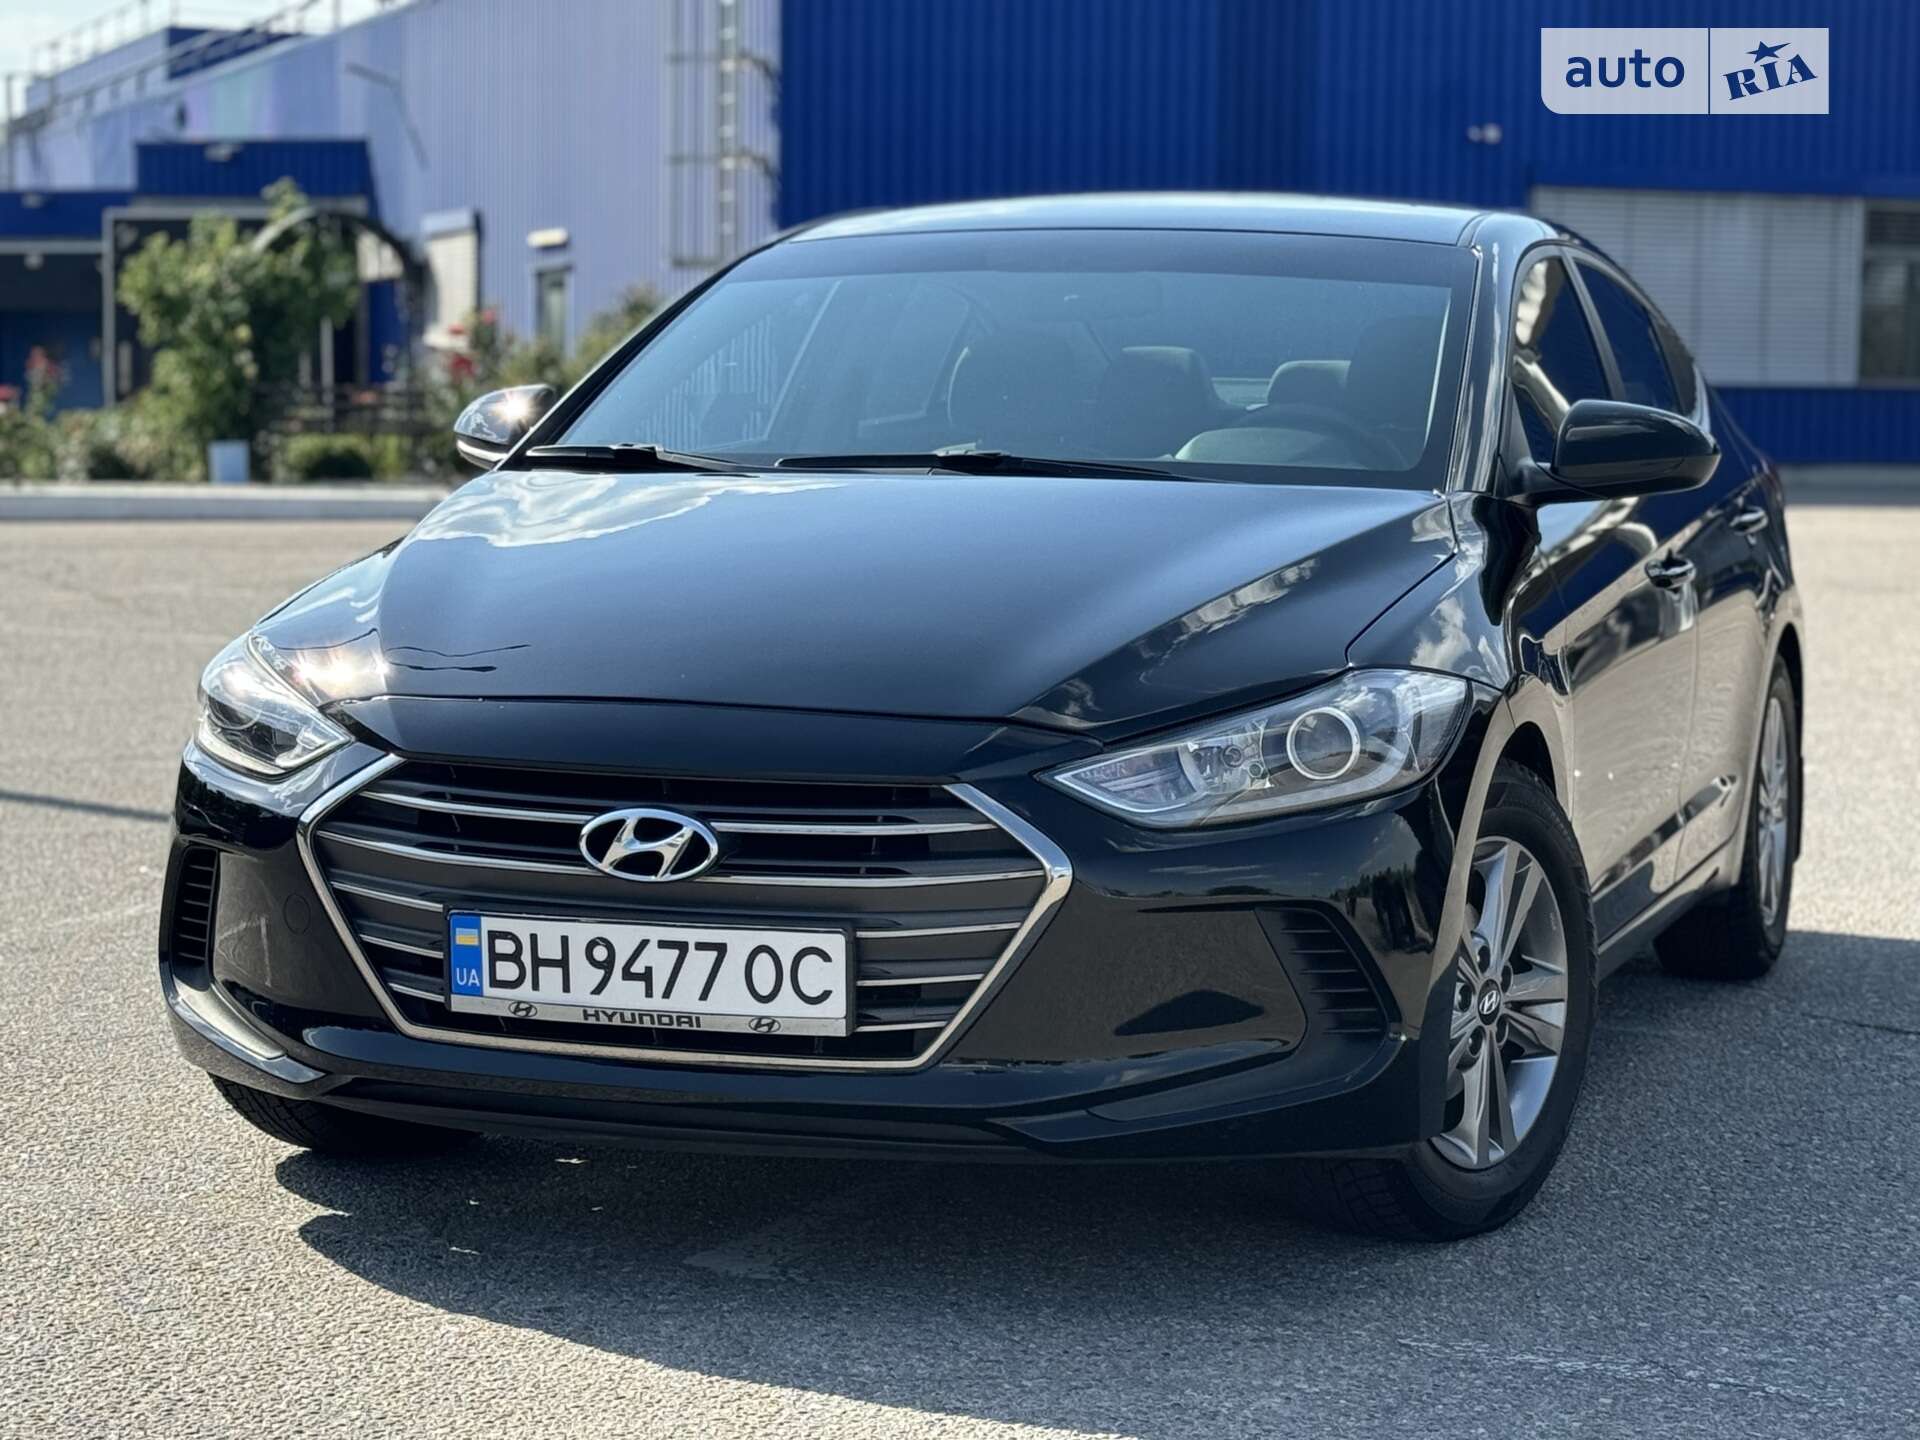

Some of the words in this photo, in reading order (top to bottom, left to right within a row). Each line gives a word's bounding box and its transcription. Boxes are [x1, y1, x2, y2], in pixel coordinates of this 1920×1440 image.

[456, 967, 481, 987] UA
[487, 930, 571, 994] BH
[584, 936, 728, 1001] 9477
[744, 943, 834, 1005] OC
[582, 1008, 702, 1028] HYUNDAI
